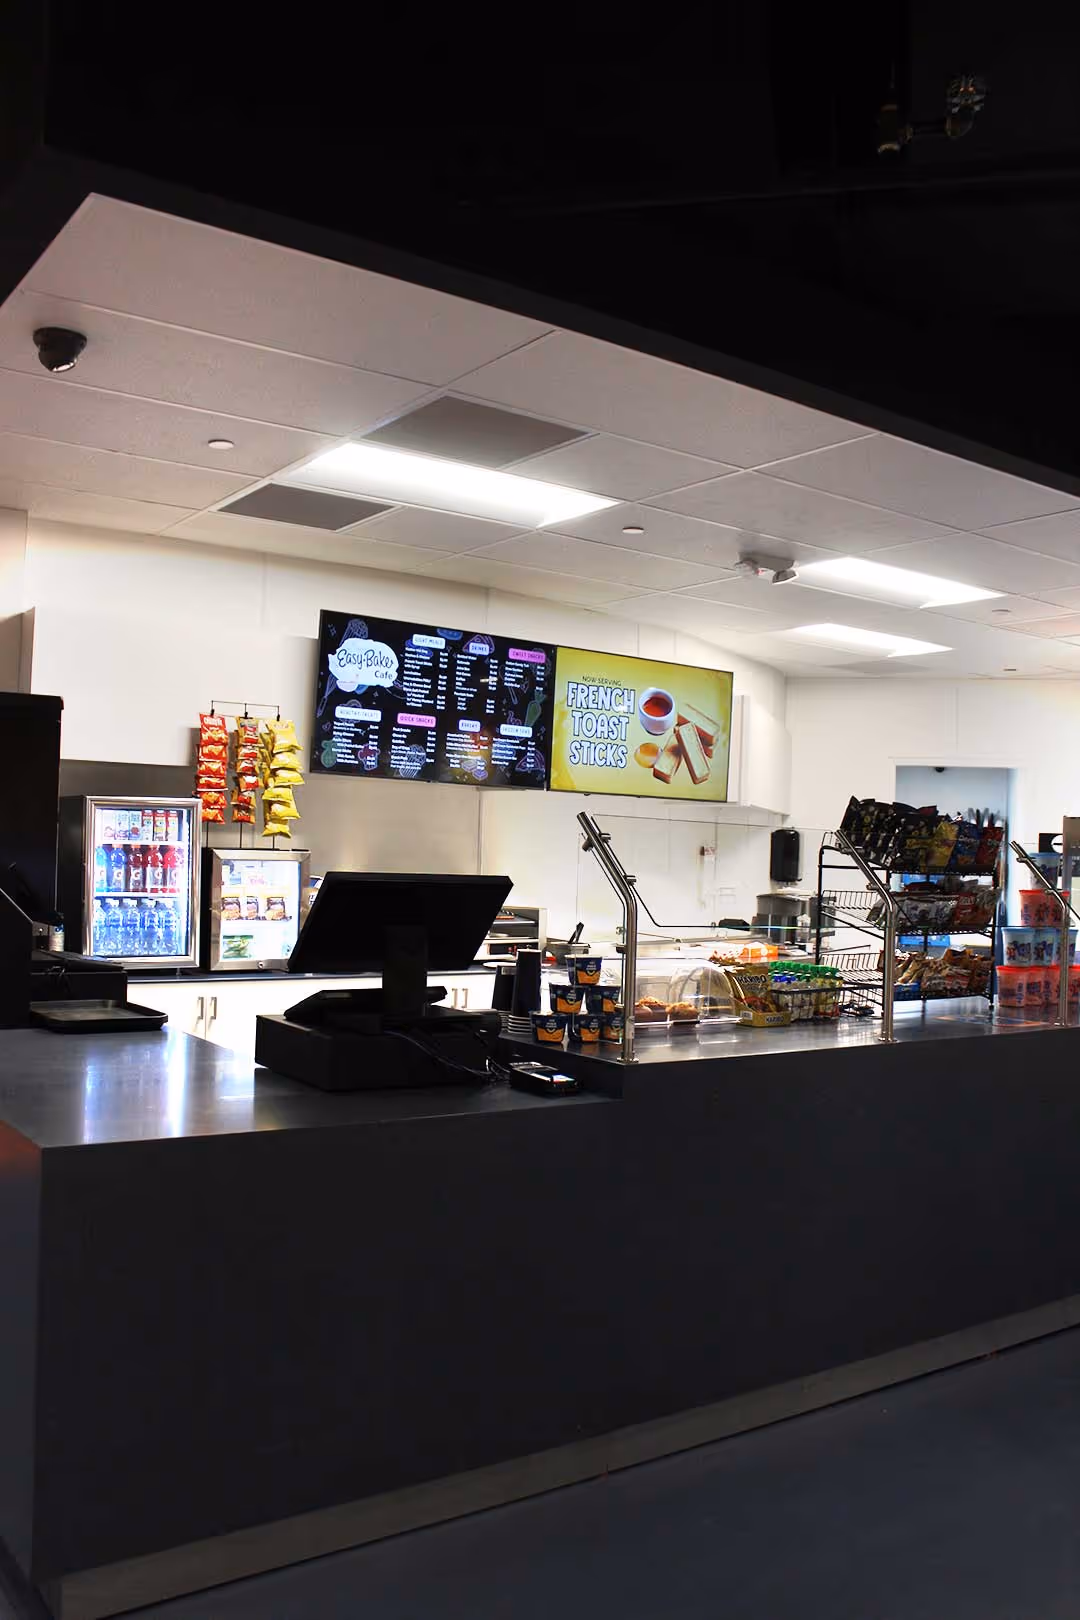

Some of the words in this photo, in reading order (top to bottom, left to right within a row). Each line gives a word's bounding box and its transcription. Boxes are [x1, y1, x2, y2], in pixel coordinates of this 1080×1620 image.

[582, 675, 596, 683] NOW
[597, 677, 622, 686] SERVING
[567, 681, 635, 714] FRENCH
[572, 710, 629, 741] TOAST
[569, 740, 628, 769] STICKS
